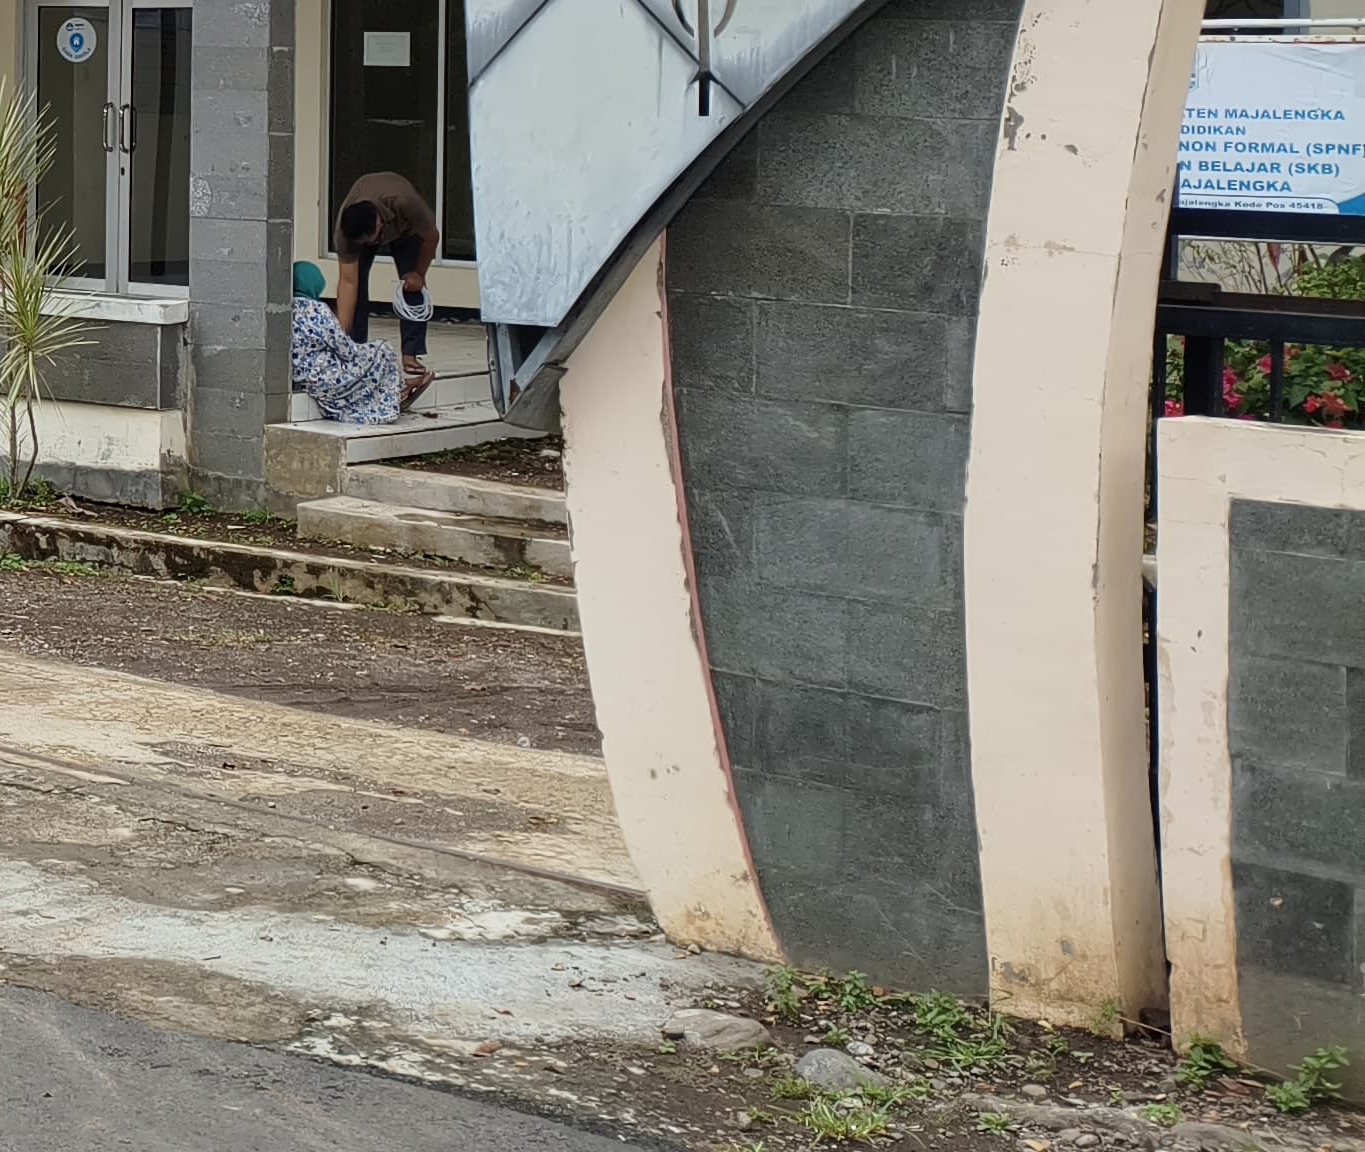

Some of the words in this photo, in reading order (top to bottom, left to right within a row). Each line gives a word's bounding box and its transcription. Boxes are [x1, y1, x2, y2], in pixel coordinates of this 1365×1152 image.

[1183, 108, 1218, 119] TEN
[1224, 109, 1345, 121] MAJALENGKA
[1179, 140, 1216, 152] NON
[1224, 141, 1300, 154] FORMAL
[1198, 161, 1281, 173] BELAJAR
[1288, 162, 1340, 178] (SKB)
[1266, 201, 1286, 209] Pos
